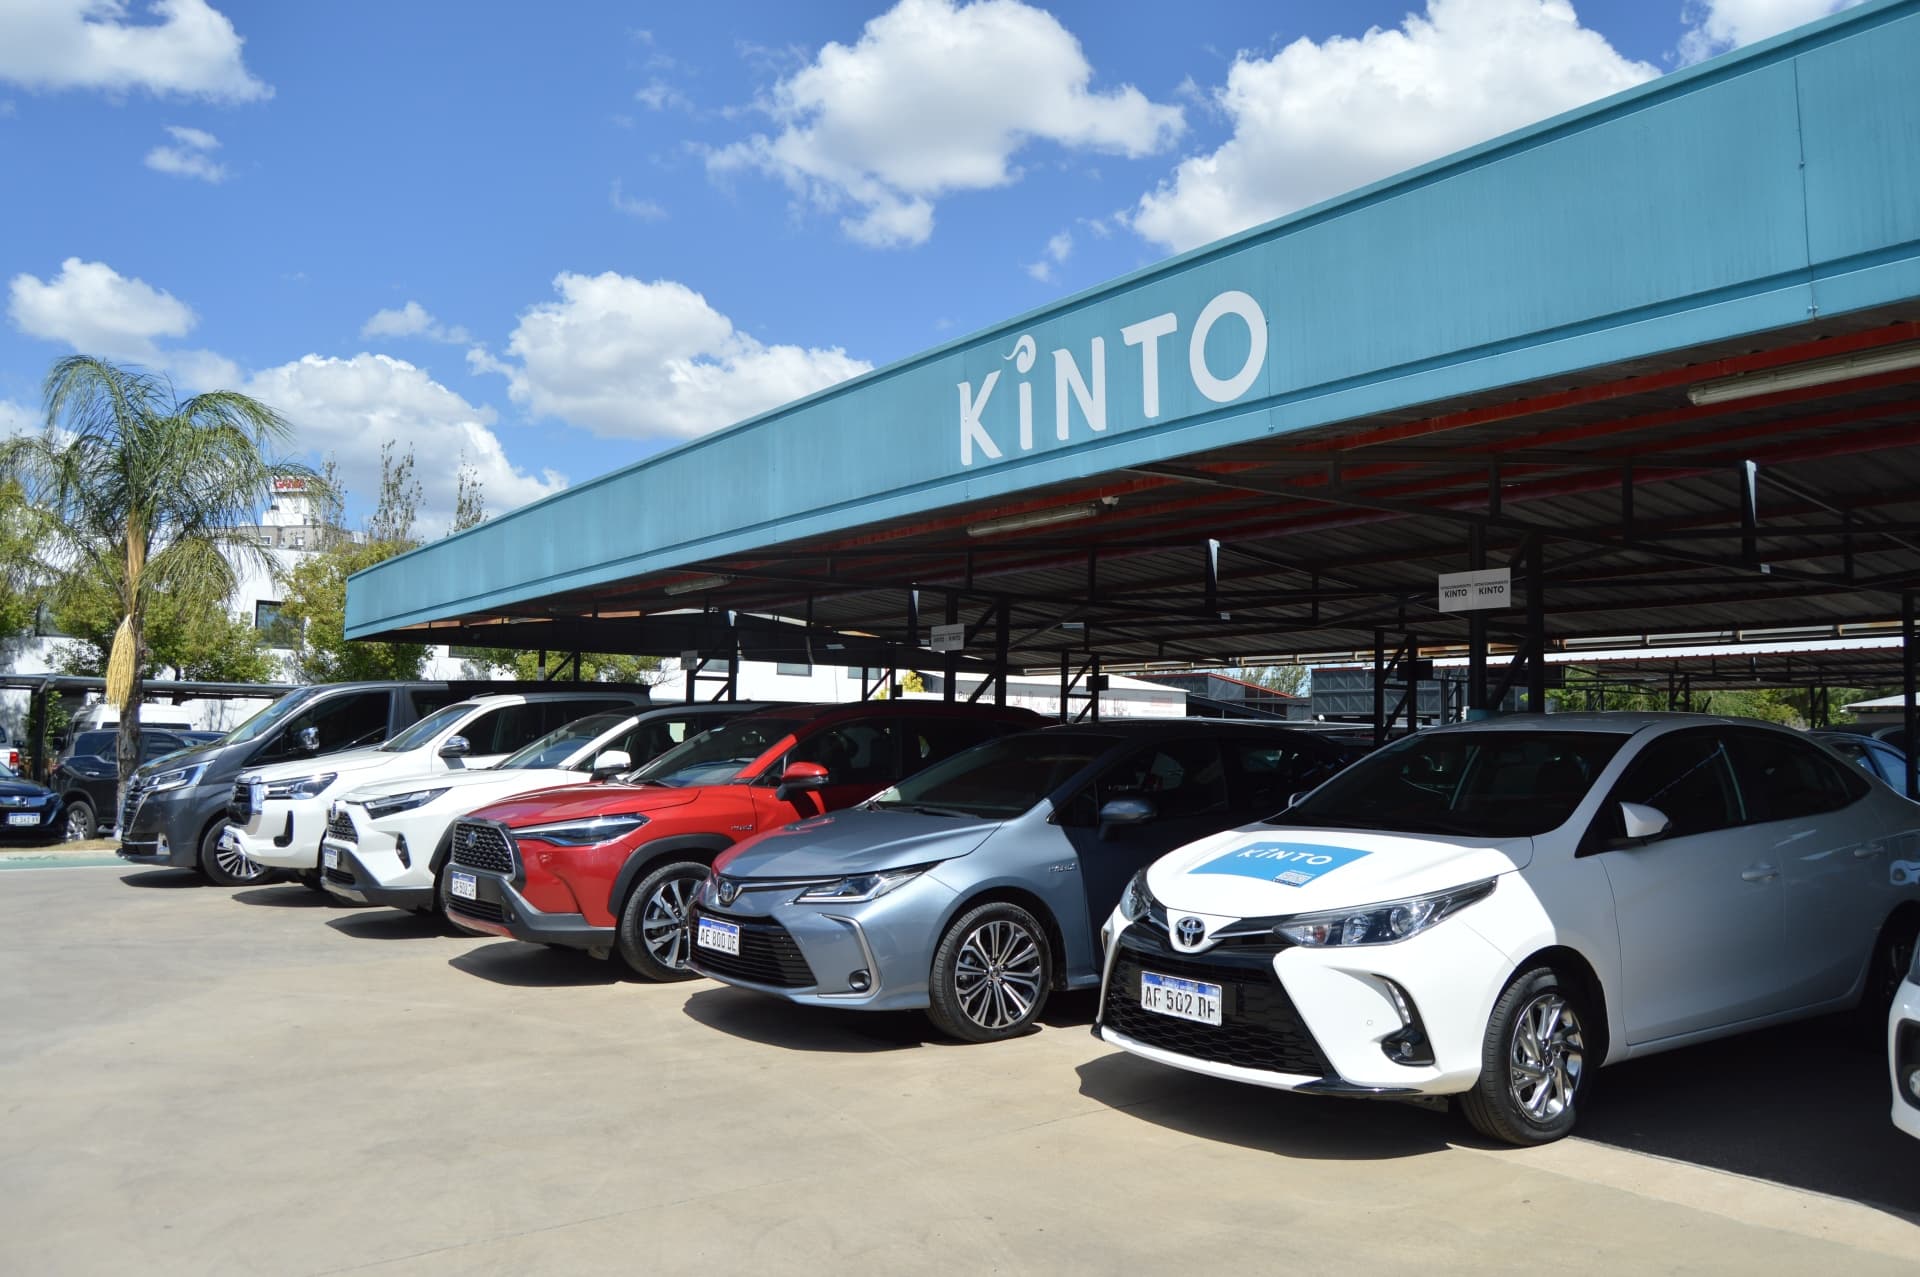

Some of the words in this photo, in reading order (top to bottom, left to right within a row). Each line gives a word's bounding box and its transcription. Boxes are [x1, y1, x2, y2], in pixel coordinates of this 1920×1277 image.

[1444, 589, 1467, 598] KINTO
[1479, 586, 1504, 595] KINTO
[700, 928, 711, 945] AE
[713, 930, 726, 948] 800
[1145, 985, 1162, 1008] AF
[1166, 990, 1193, 1015] 502
